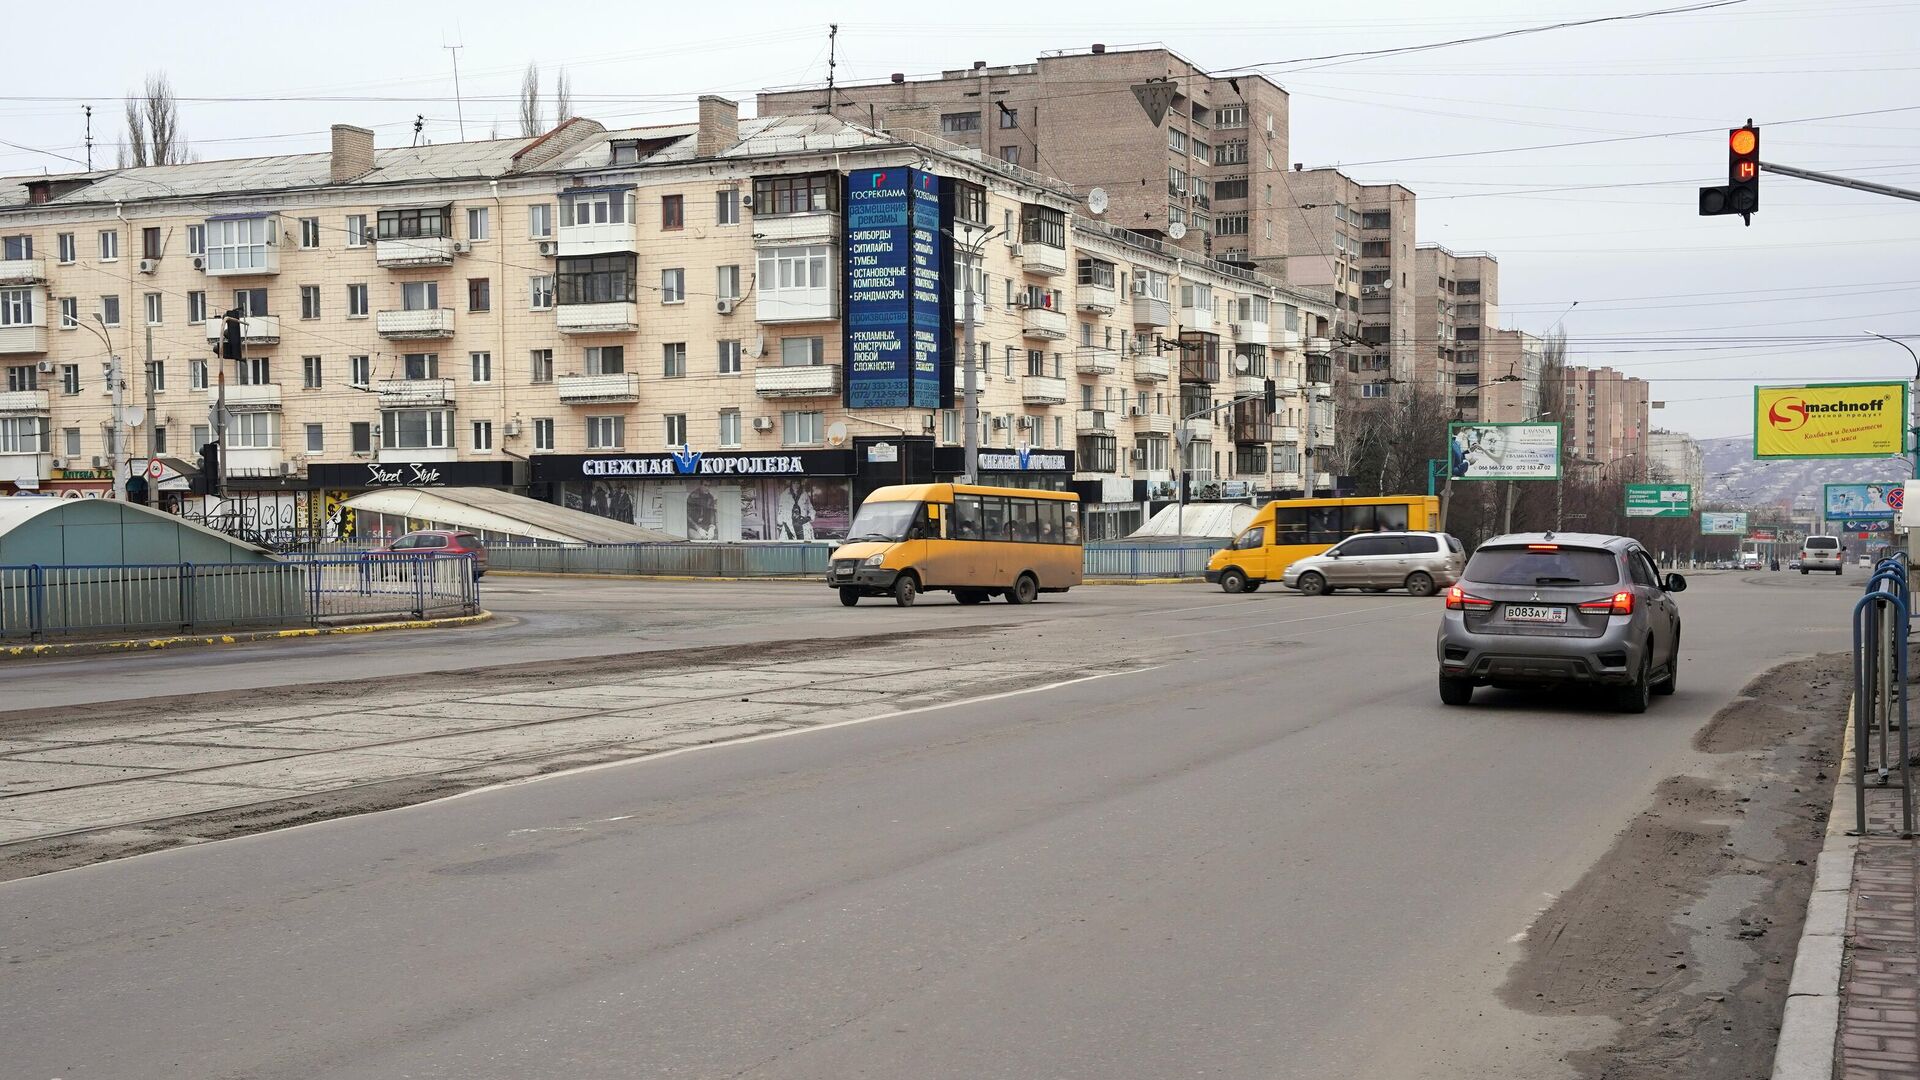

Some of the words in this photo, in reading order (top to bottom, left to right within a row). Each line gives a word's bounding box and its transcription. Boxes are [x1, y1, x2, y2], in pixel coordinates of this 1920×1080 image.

[1741, 163, 1754, 177] 14
[851, 188, 906, 200] ГОСРЕКЛАМА
[858, 213, 898, 227] рекламы
[853, 230, 891, 240] БИЛБОРДЫ
[853, 241, 893, 253] СИТИЛАЙТЫ
[854, 256, 878, 266] ТУМБЫ
[853, 267, 907, 278] ОСТАНОВОЧНЫЕ
[853, 278, 895, 288] КОМПЛЕКСЫ
[853, 290, 904, 301] БРАНДМАУЭРЫ
[854, 331, 895, 341] РЕКЛАМНЫХ
[853, 339, 901, 351] КОНСТРУКЦИЙ
[854, 349, 878, 361] ЛЮБОЙ
[853, 362, 895, 371] СЛОЖНОСТИ
[1804, 431, 1833, 440] Колбасы
[582, 458, 675, 476] СНЕЖНАЯ
[700, 456, 804, 474] КОРОЛЕВА
[365, 463, 403, 485] Street
[407, 463, 441, 485] Style
